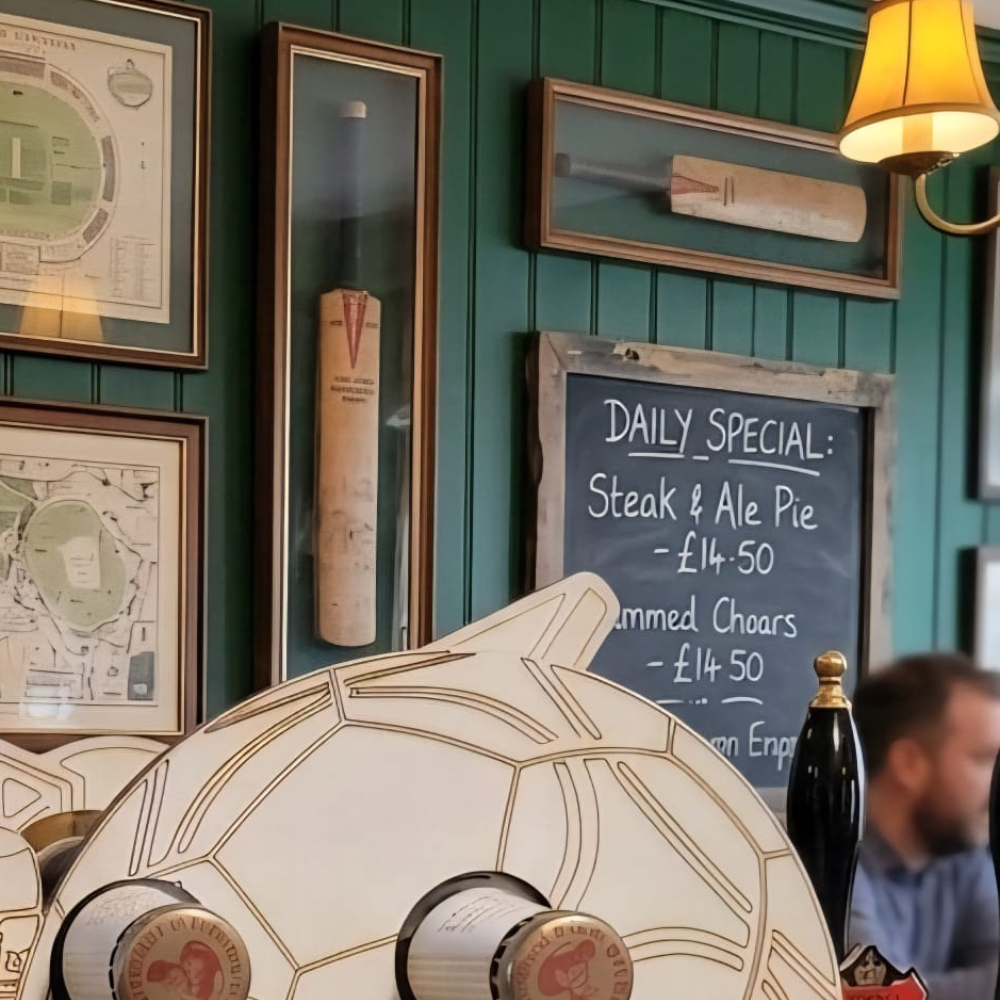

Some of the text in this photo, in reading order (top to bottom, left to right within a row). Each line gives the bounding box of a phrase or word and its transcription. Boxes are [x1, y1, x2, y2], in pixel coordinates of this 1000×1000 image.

[604, 398, 834, 461] DAILY SPECIAL:
[588, 472, 819, 530] Steak & Ale Pie
[615, 595, 798, 639] mmed Choars
